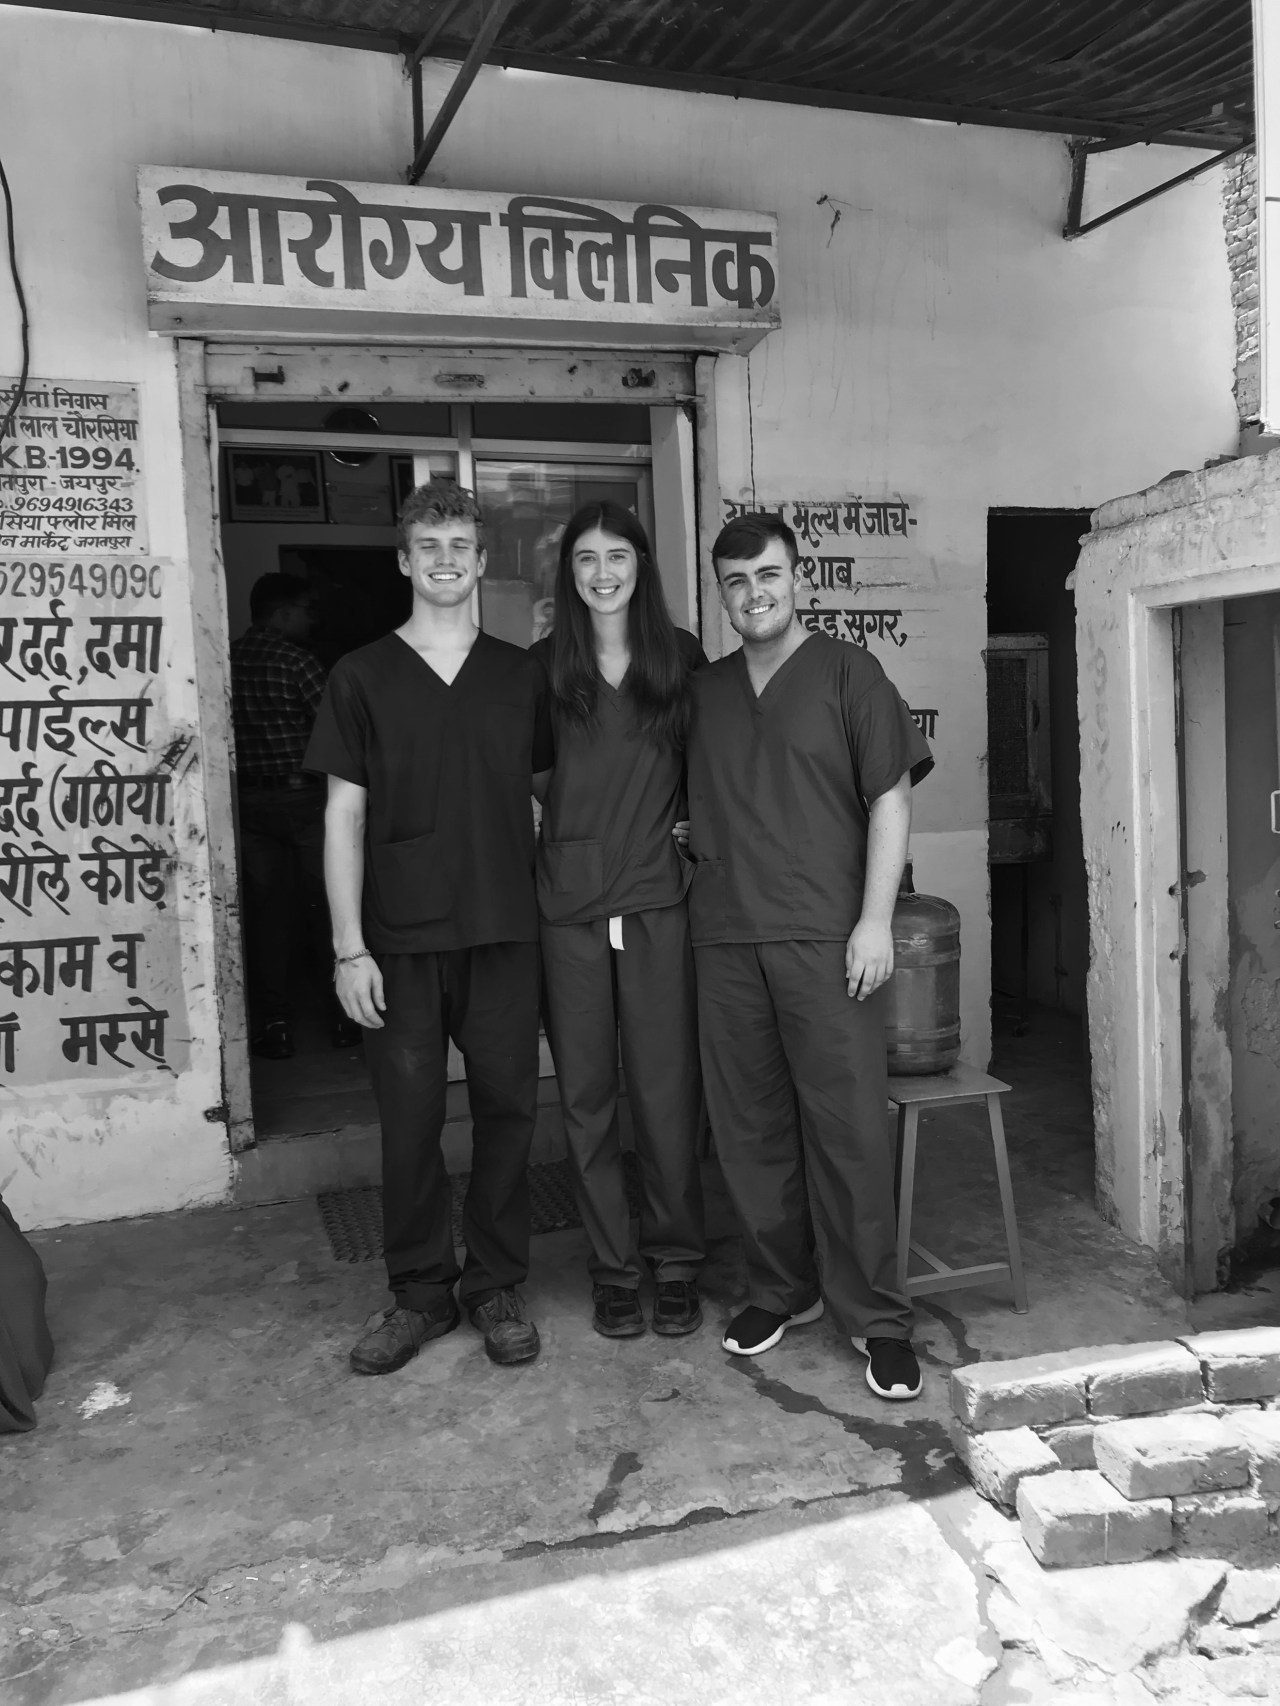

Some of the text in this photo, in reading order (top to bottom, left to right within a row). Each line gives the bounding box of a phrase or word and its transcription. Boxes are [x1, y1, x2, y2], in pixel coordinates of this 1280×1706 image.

[150, 180, 776, 310] आरोग्य क्लिनिक
[52, 387, 109, 410] निवास
[19, 415, 58, 441] लाल
[61, 411, 139, 442] चौरसिया
[0, 474, 47, 495] तपुरा
[59, 475, 123, 495] जयपुर
[10, 497, 133, 512] 9694916343
[45, 511, 99, 532] फ्लोर
[101, 511, 137, 532] मिल
[73, 536, 133, 550] जगतपुरा
[107, 933, 146, 989] व
